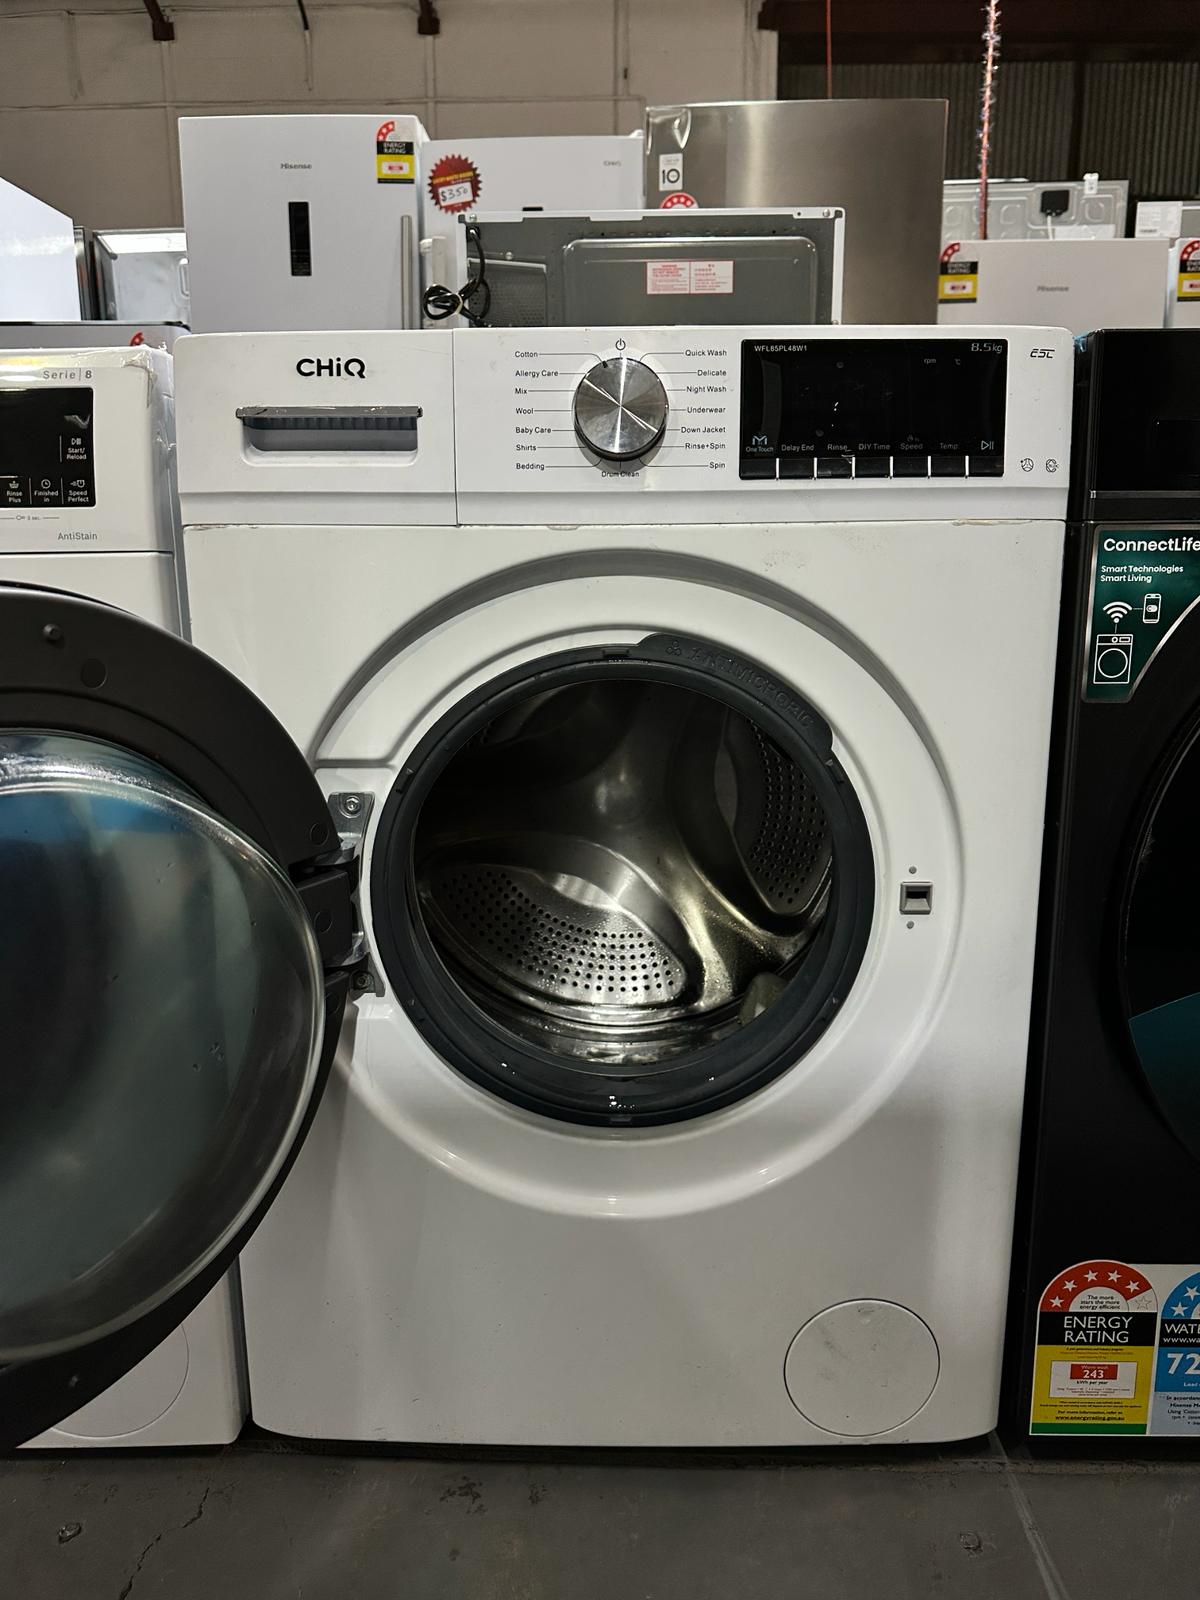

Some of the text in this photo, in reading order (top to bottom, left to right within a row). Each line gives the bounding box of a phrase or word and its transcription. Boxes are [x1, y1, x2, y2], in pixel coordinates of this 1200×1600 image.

[661, 168, 681, 184] 10
[296, 357, 366, 379] CHiQ
[43, 370, 76, 379] Serie
[515, 370, 539, 378] Allergy
[686, 386, 705, 394] Night
[515, 427, 534, 435] Baby
[781, 444, 800, 452] Delay
[858, 443, 872, 451] DIY
[900, 442, 924, 451] Speed
[516, 463, 545, 471] Bedding
[58, 532, 98, 541] AntiStain
[1103, 537, 1200, 552] ConnectLife
[1101, 565, 1184, 574] Smart Technologies
[1100, 574, 1153, 583] Smart Living
[1063, 1316, 1133, 1329] ENERGY
[1064, 1330, 1130, 1343] RATING
[1167, 1353, 1200, 1375] 72
[1083, 1370, 1105, 1379] 243
